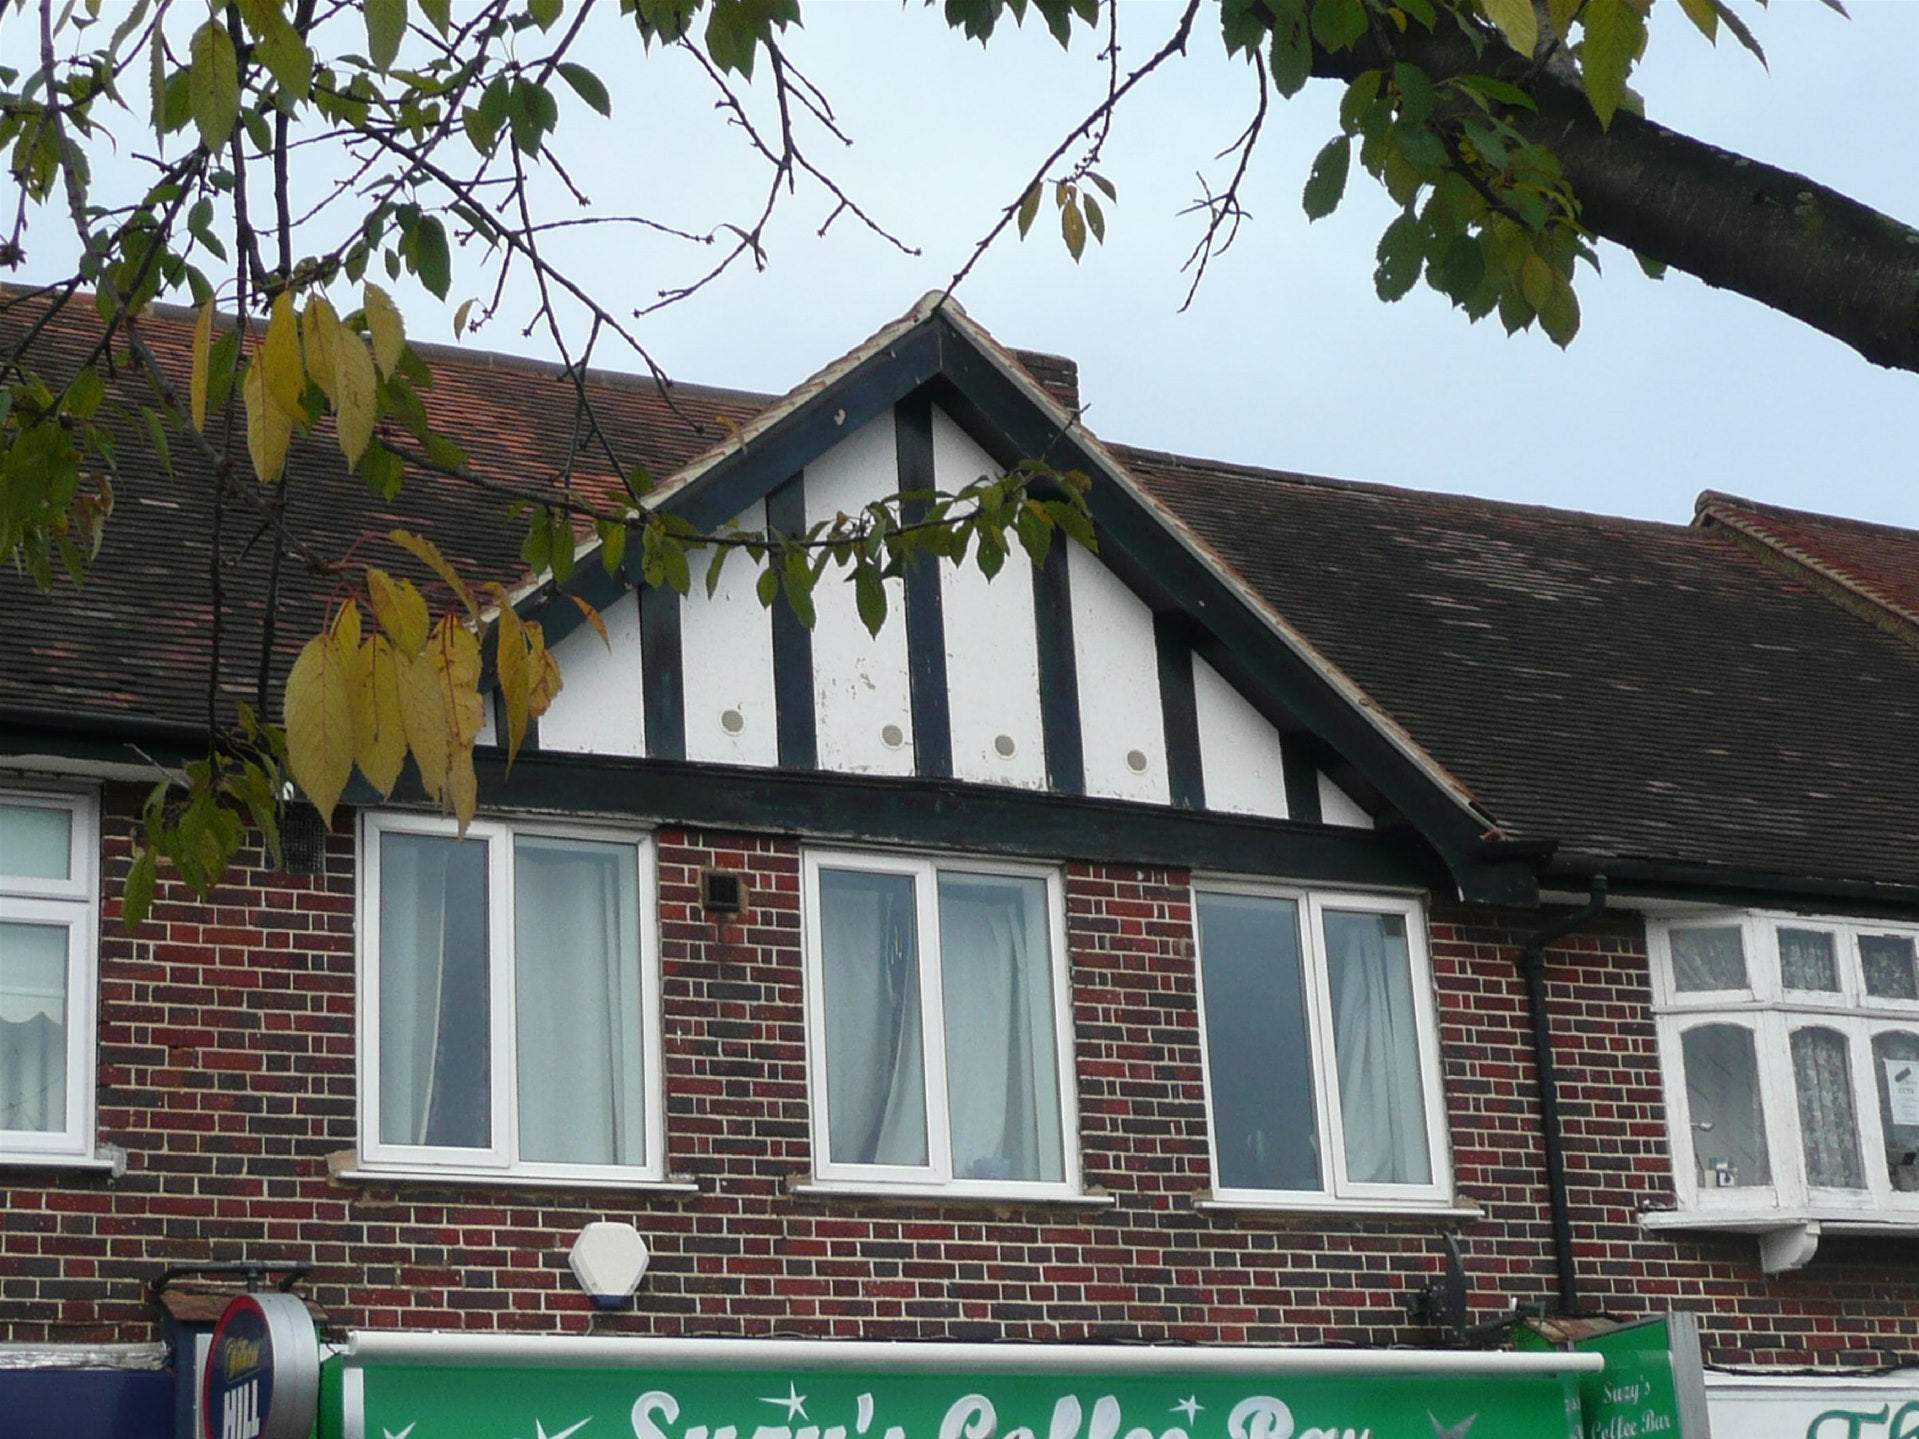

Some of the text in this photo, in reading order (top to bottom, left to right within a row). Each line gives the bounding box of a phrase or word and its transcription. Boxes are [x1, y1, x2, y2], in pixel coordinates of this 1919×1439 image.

[1603, 1375, 1651, 1405] Suzy's
[223, 1379, 260, 1439] HILL
[1641, 1409, 1670, 1433] Bar
